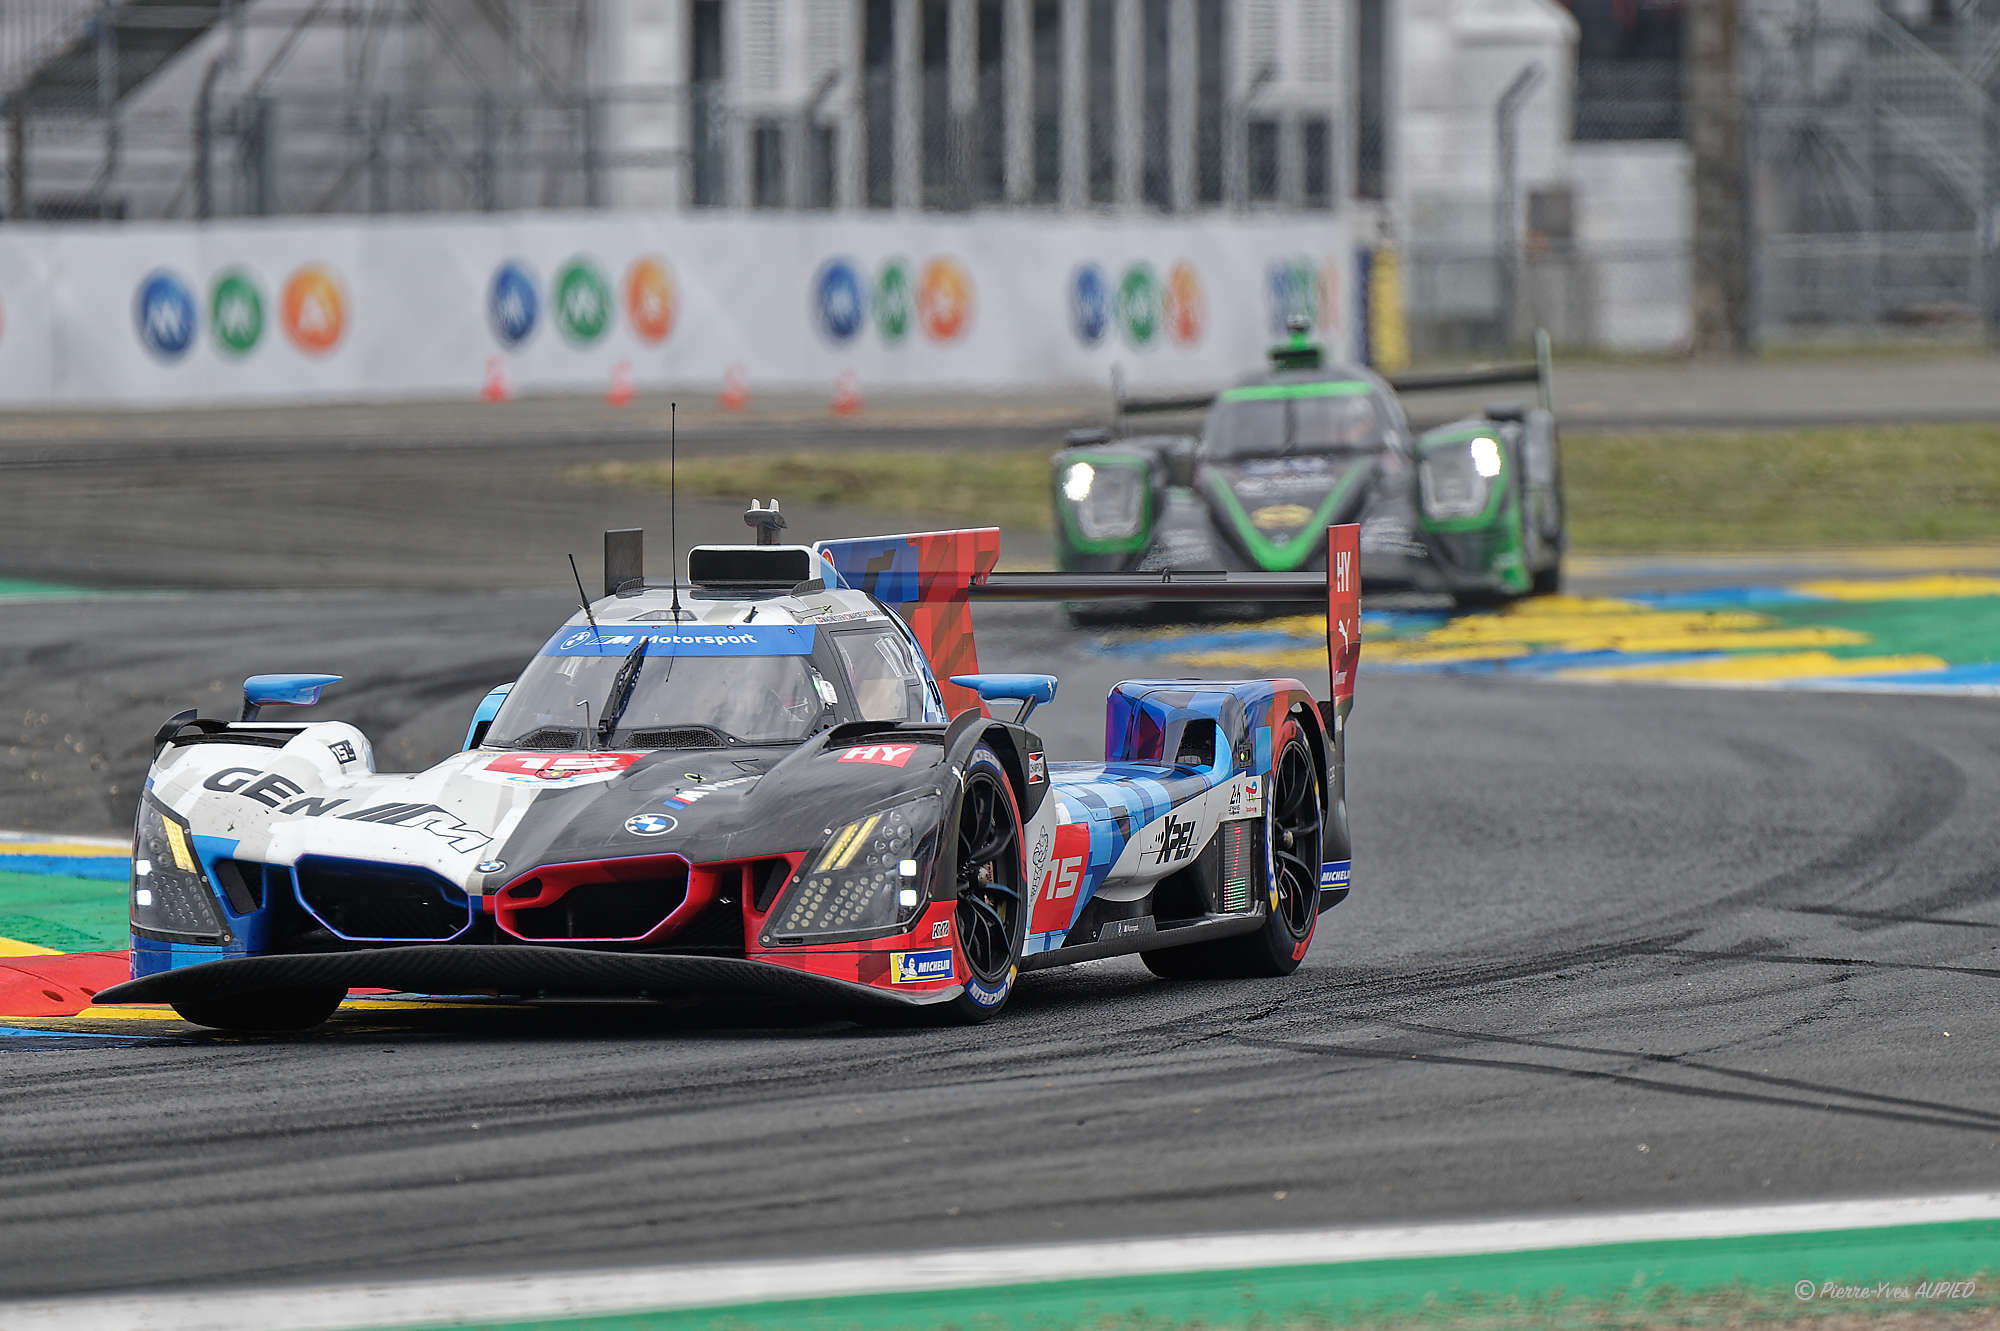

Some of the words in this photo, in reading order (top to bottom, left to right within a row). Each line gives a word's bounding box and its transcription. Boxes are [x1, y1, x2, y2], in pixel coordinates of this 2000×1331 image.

[1336, 551, 1351, 593] HY
[639, 633, 758, 646] Motorsport
[516, 757, 620, 770] 15
[843, 746, 912, 762] HY
[203, 767, 350, 817] GEN
[1155, 814, 1197, 865] XPEL
[1046, 855, 1083, 900] 15
[917, 959, 950, 973] MICHELIN
